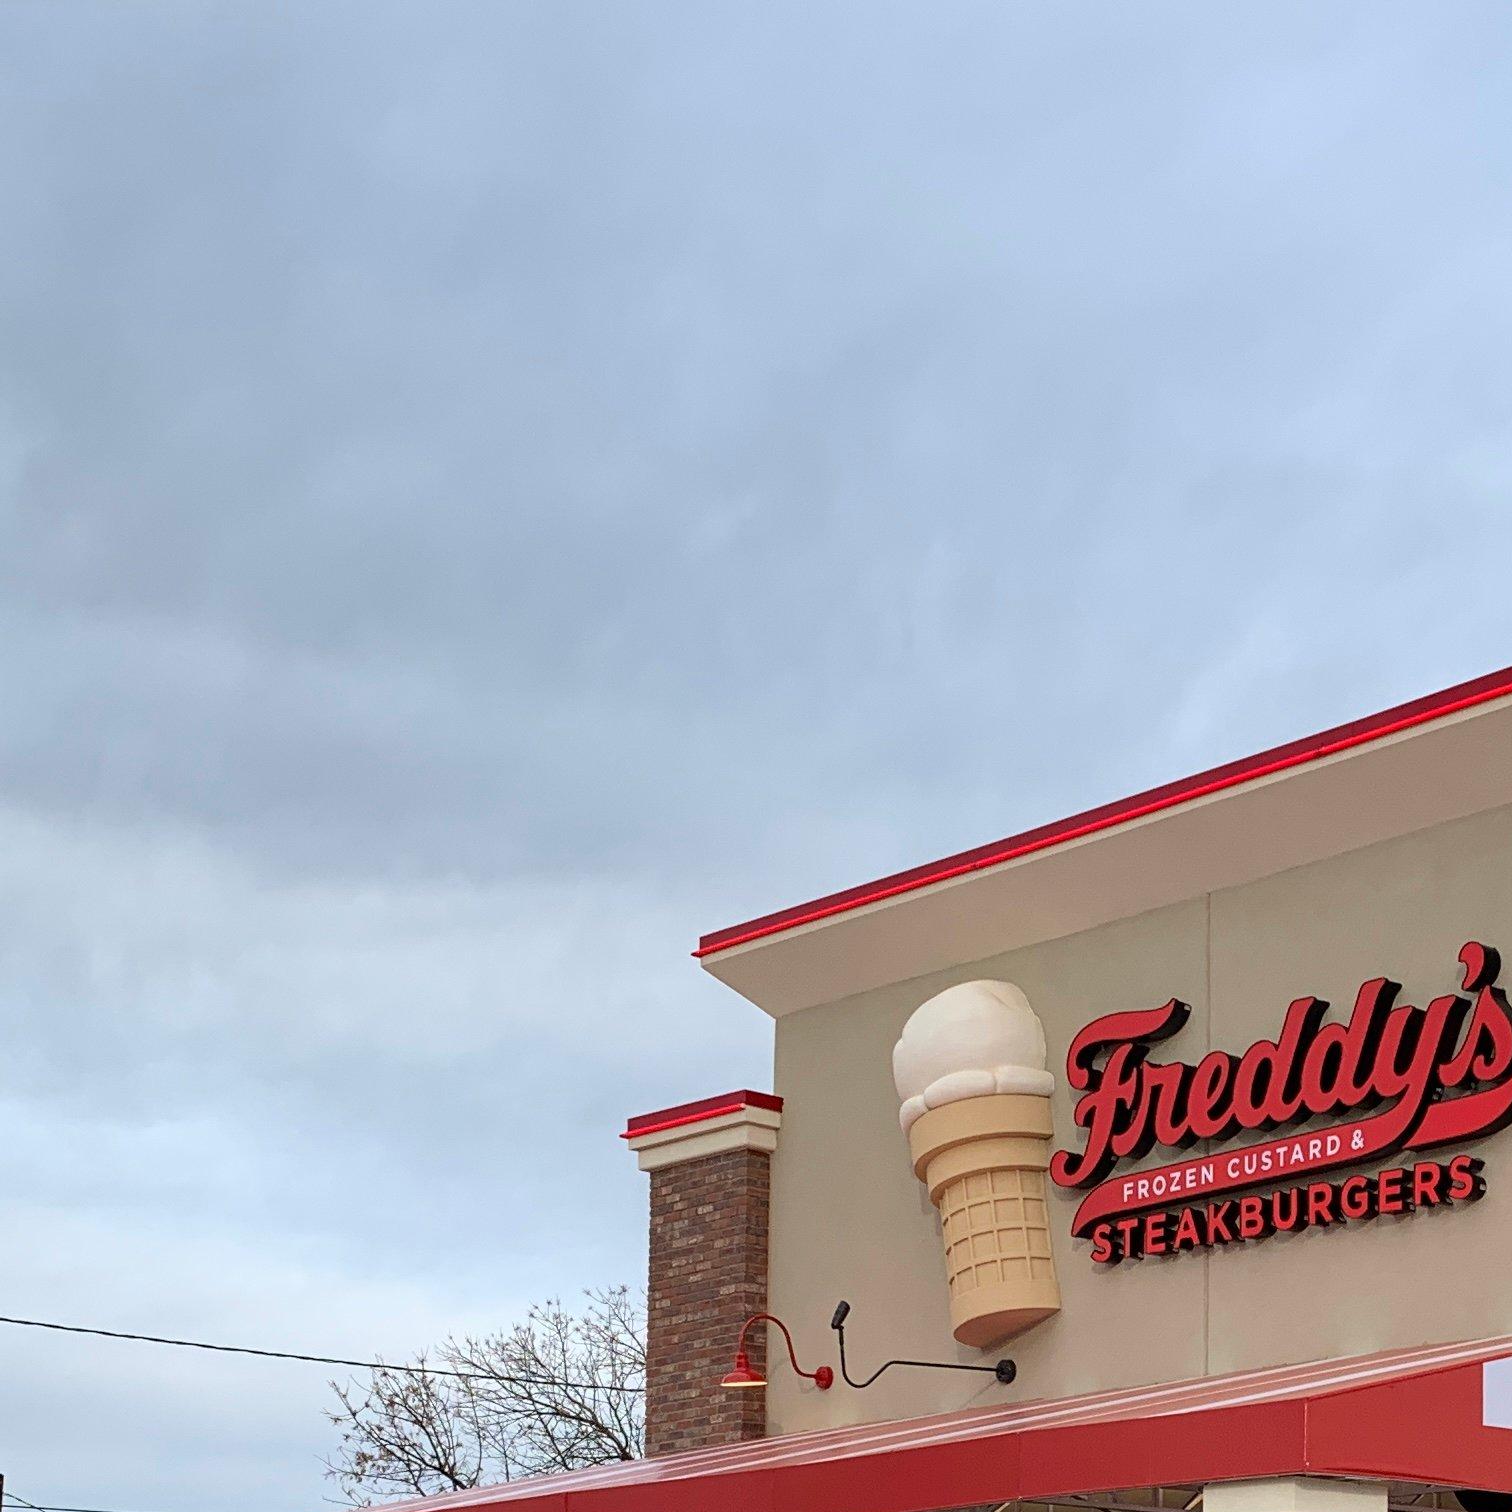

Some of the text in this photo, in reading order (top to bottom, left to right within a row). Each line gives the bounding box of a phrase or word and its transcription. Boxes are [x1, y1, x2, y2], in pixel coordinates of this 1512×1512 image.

[1091, 1156, 1487, 1263] STEAKBURGERS
[1123, 1129, 1364, 1202] FROZEN CUSTARD &
